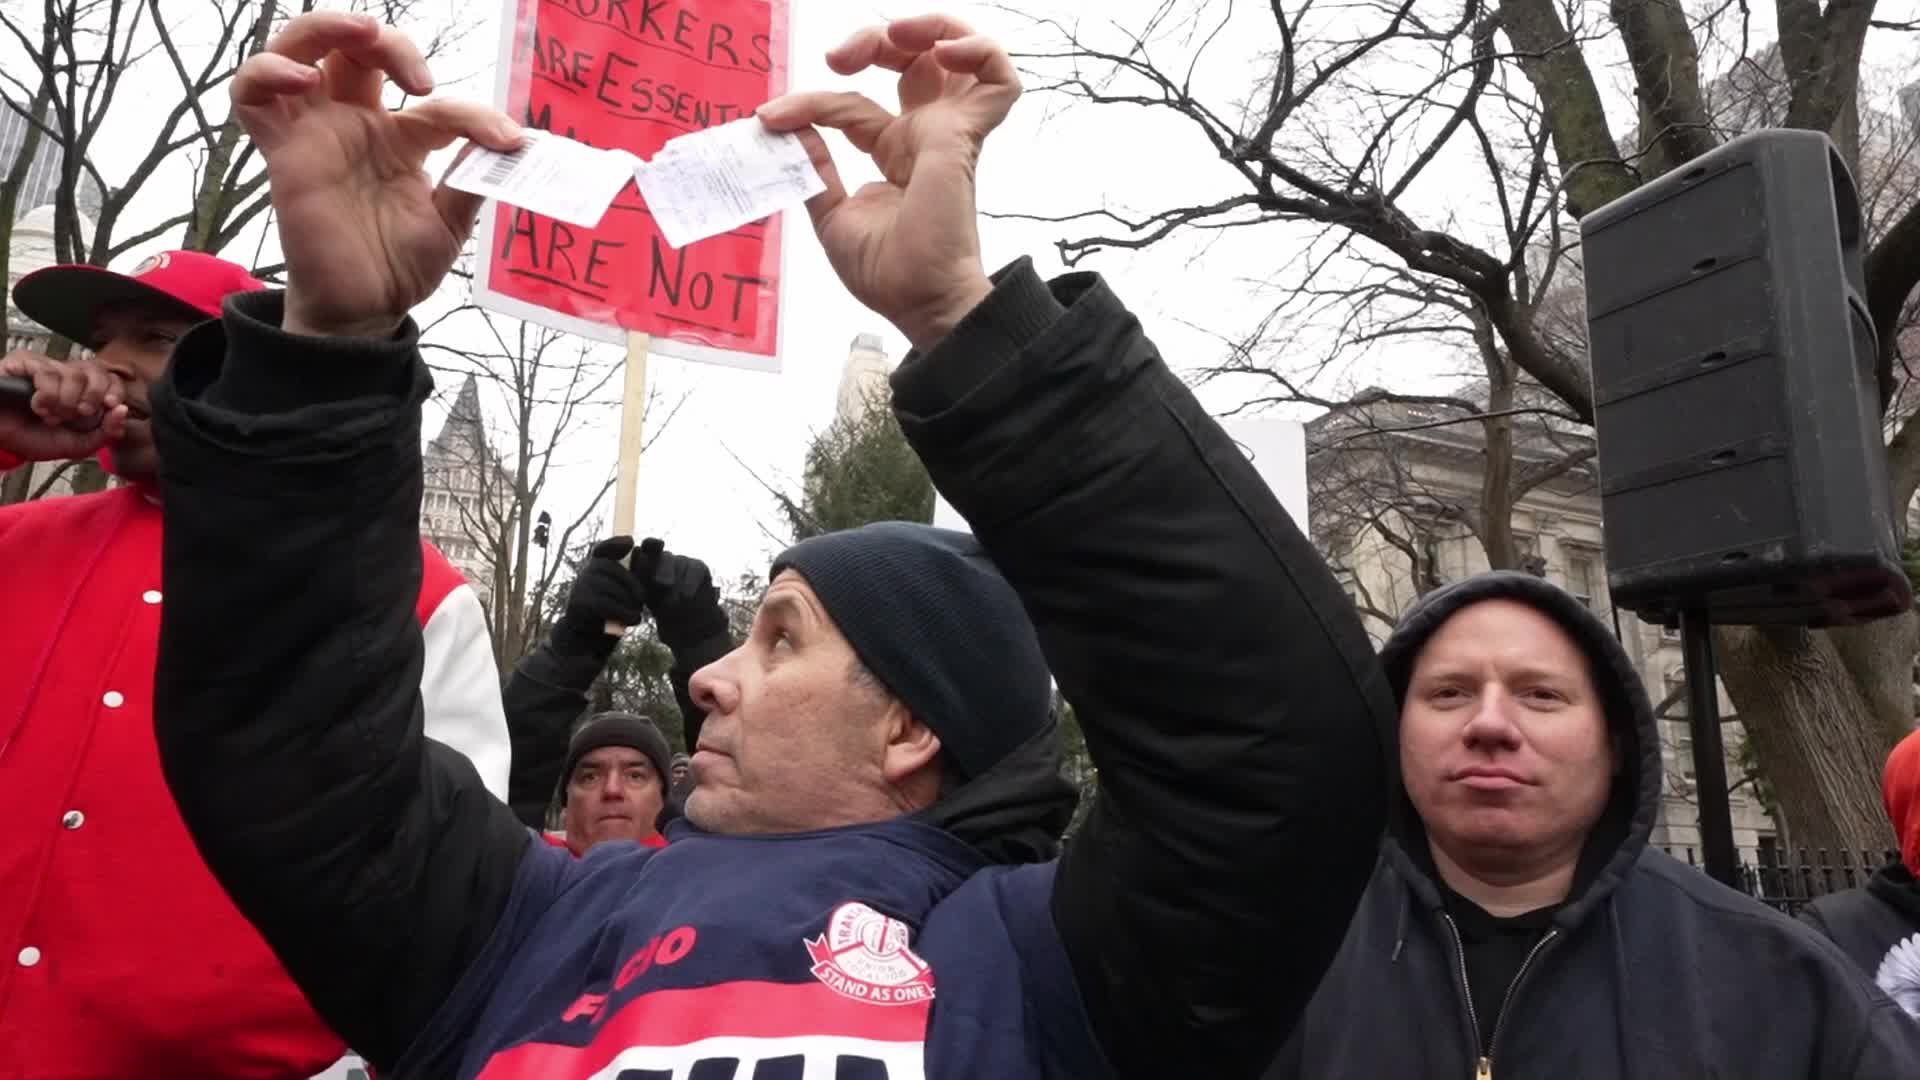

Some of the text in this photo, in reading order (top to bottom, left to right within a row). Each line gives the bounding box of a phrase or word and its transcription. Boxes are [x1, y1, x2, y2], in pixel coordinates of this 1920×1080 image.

[519, 20, 593, 89] ARE
[597, 52, 757, 127] ESSENT
[560, 0, 773, 73] ORKERS
[502, 207, 769, 322] ARE NOT
[821, 967, 927, 1002] STAND AS ONE
